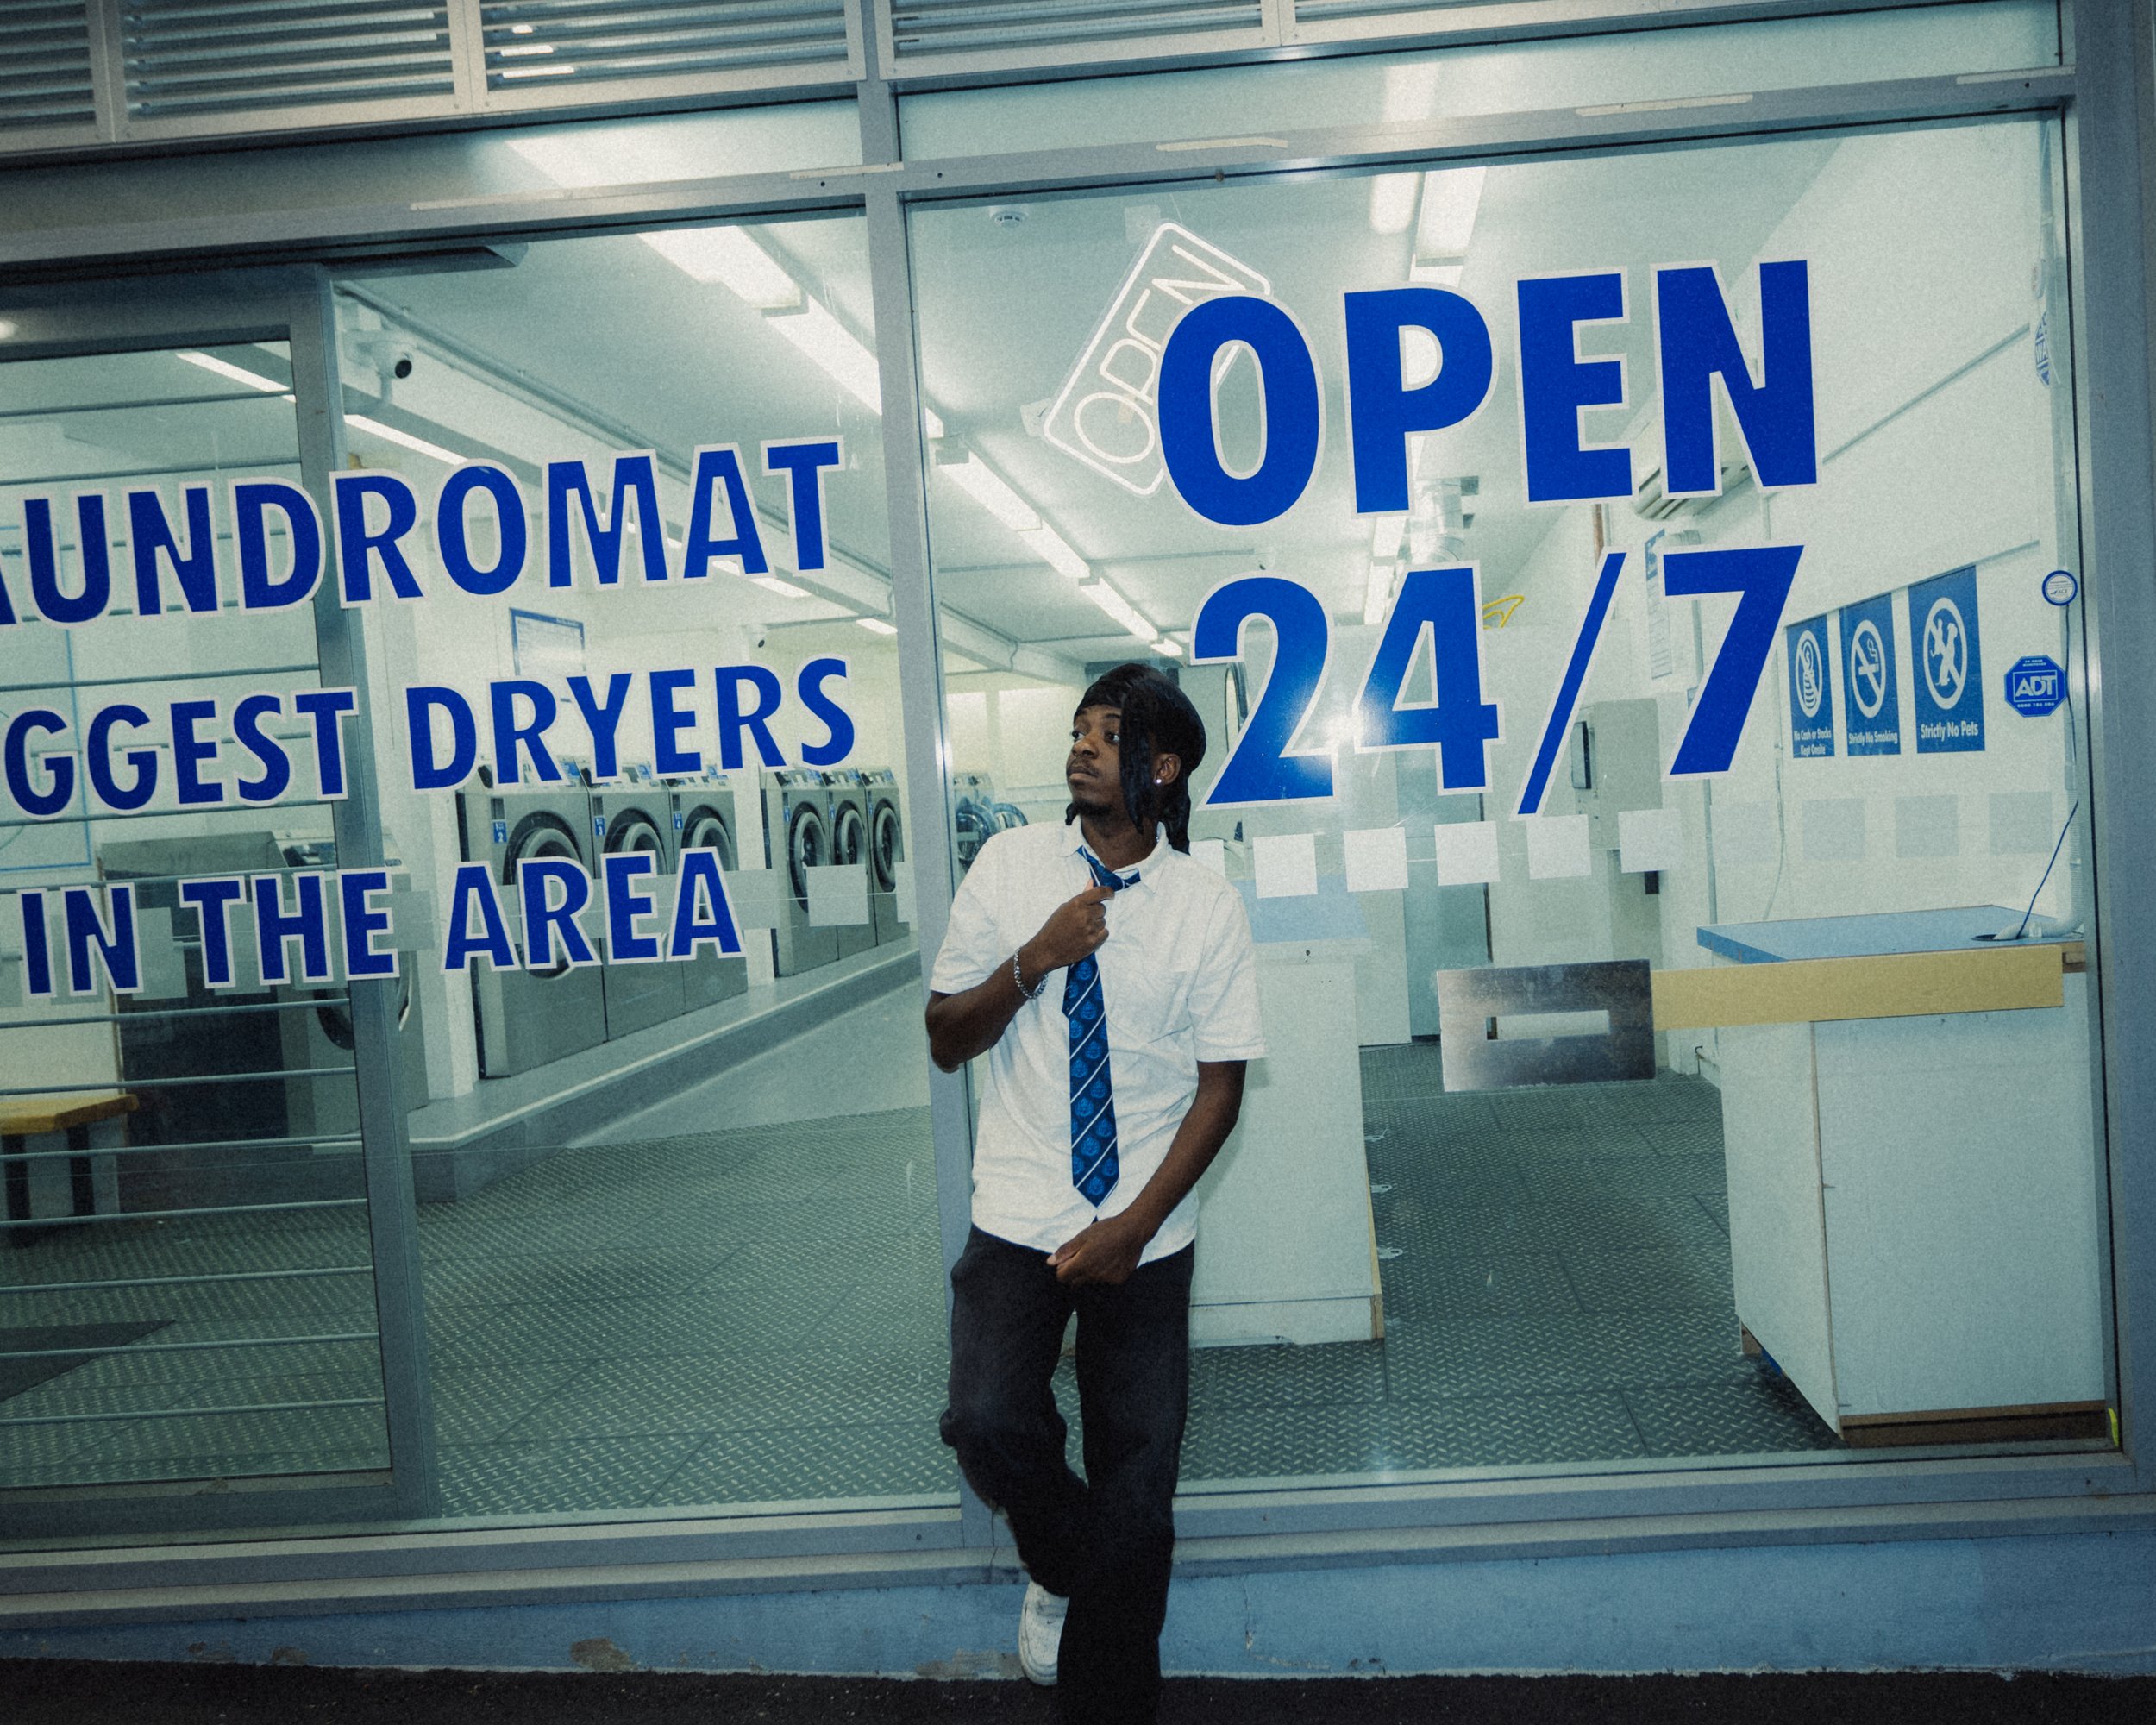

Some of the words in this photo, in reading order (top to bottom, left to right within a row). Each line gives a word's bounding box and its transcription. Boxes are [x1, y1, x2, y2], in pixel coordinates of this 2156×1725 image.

[1158, 260, 1817, 526] OPEN
[0, 442, 840, 625] UNDROMAT
[407, 658, 855, 789] DRYERS
[1195, 545, 1804, 815] 24/7
[1849, 732, 1865, 747] Strictly
[1865, 731, 1874, 743] No
[1874, 730, 1898, 745] Smoking
[1921, 721, 1946, 743] Strictly
[1946, 721, 1960, 738] No
[1960, 719, 1980, 737] Pets
[2015, 675, 2057, 697] ADT
[498, 831, 505, 844] 2
[22, 889, 136, 994] IN
[183, 872, 395, 982] THE
[446, 852, 742, 969] AREA
